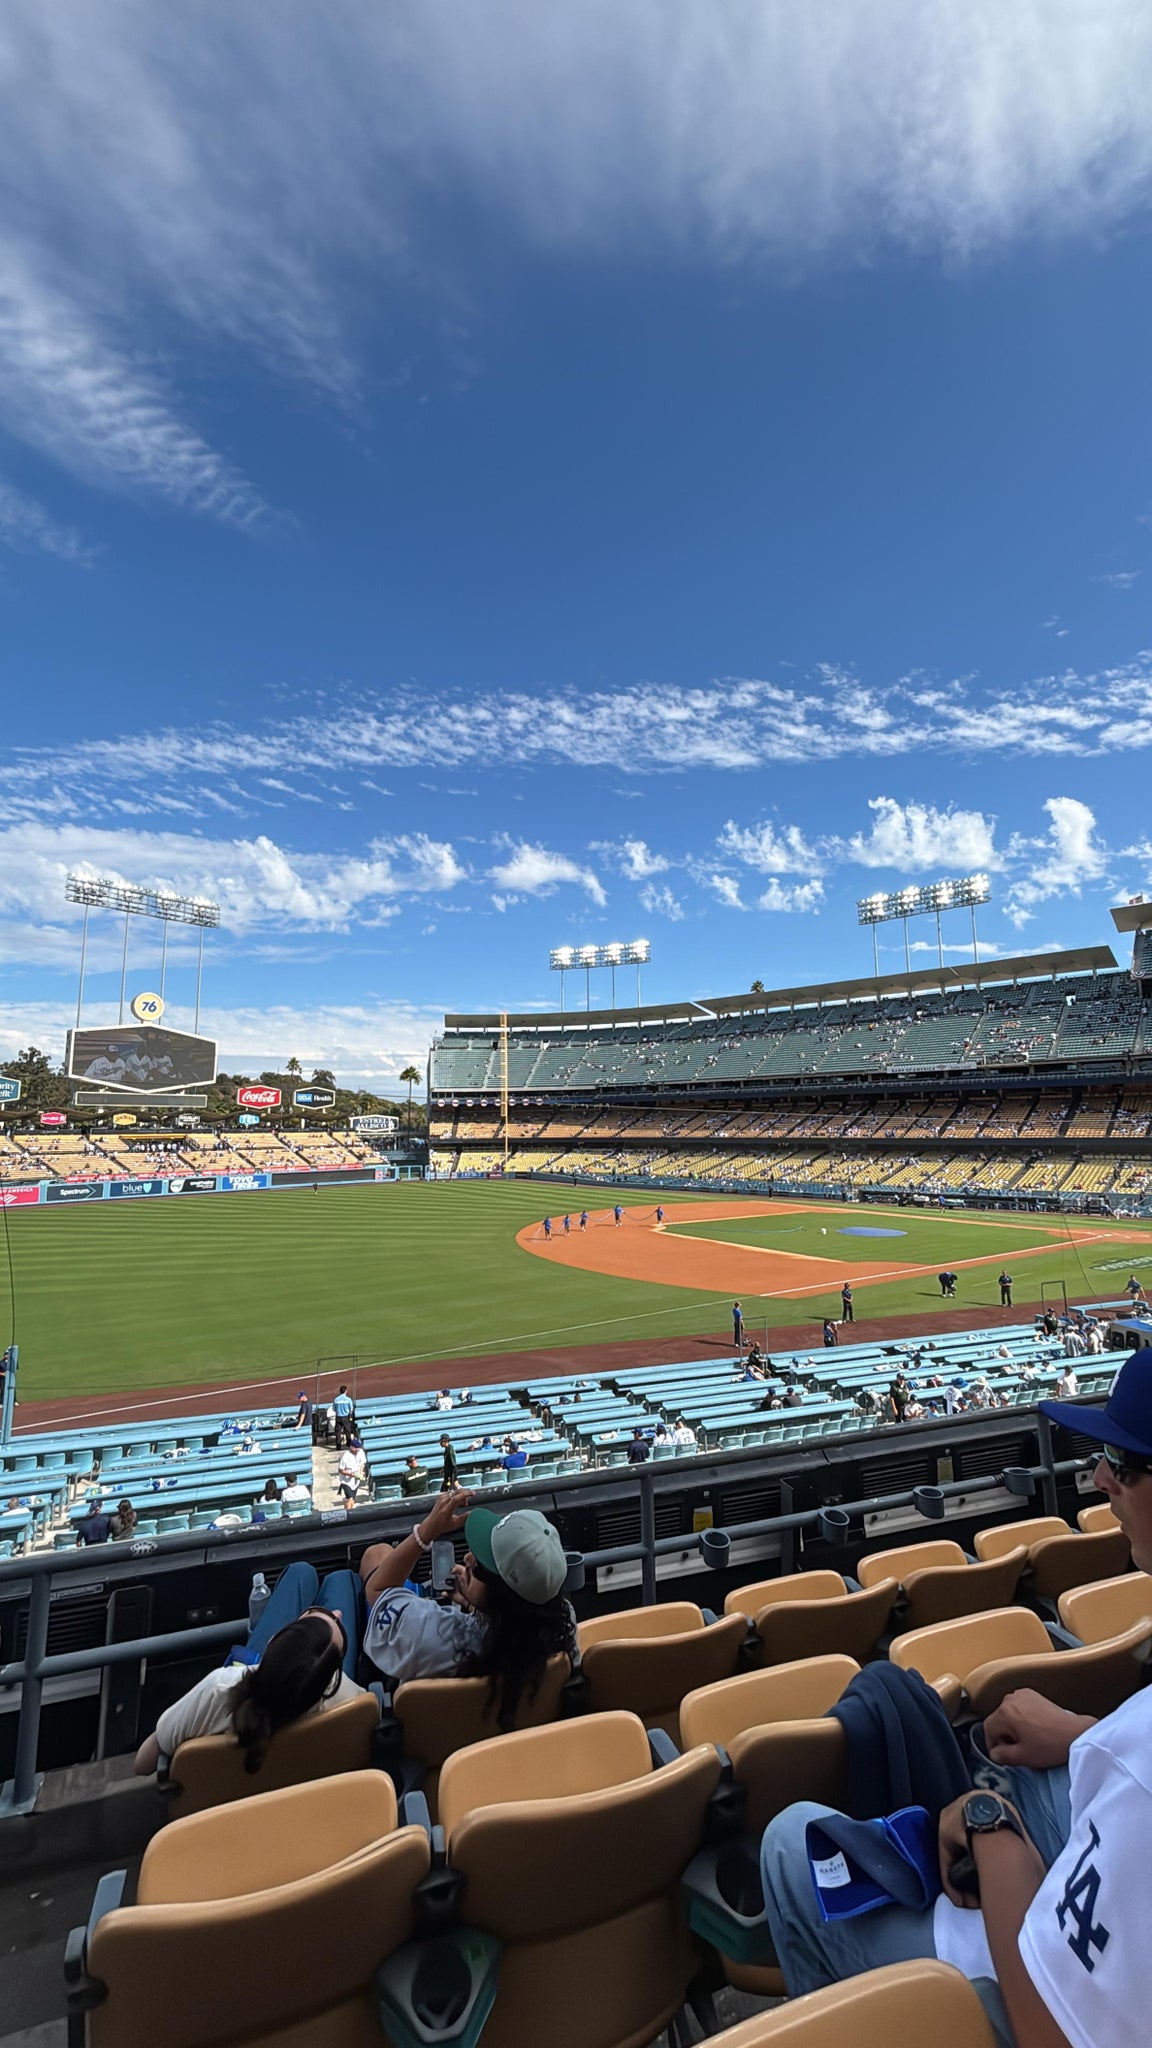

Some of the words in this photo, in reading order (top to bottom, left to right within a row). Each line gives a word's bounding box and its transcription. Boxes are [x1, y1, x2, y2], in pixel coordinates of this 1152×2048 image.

[142, 1001, 157, 1012] 76
[122, 1184, 143, 1192] blue
[232, 1181, 260, 1190] TIRES
[60, 1188, 90, 1196] Spectrum
[376, 1602, 409, 1631] LA
[1054, 1819, 1110, 1973] LA
